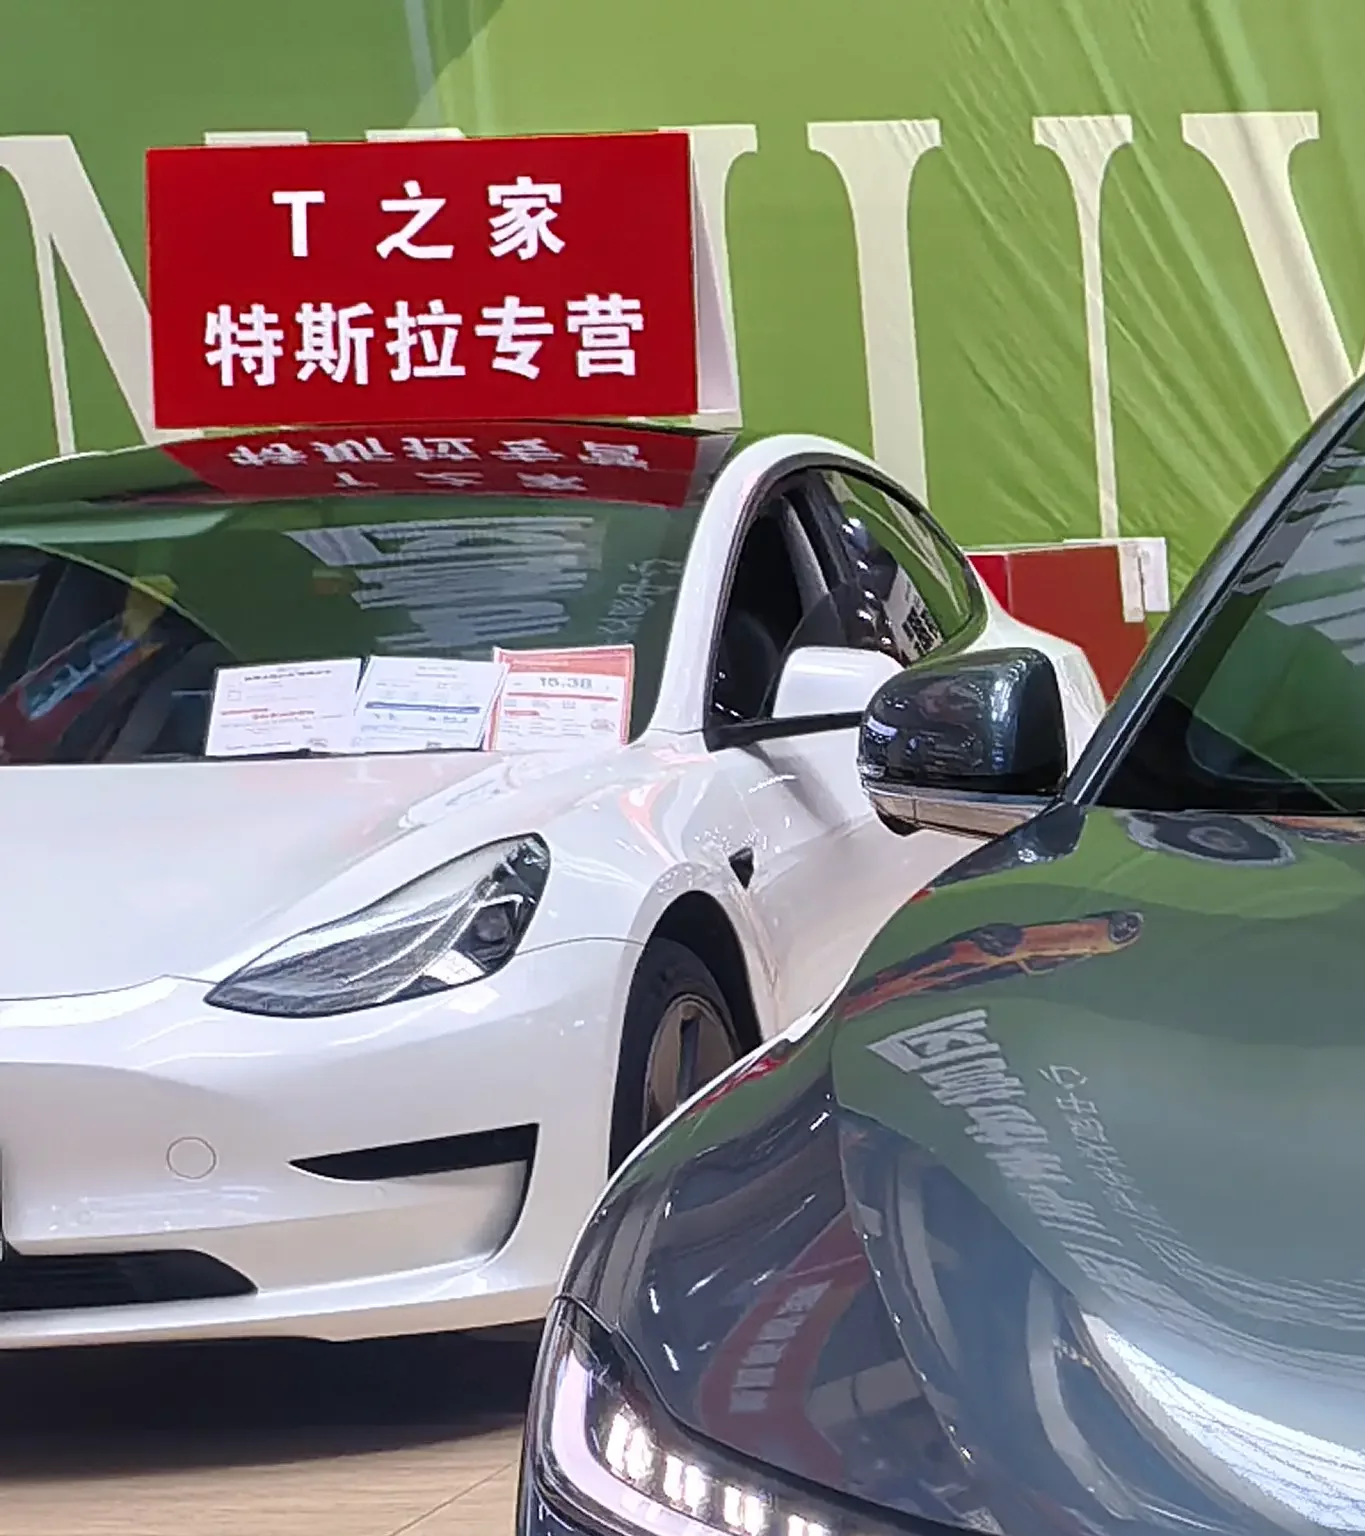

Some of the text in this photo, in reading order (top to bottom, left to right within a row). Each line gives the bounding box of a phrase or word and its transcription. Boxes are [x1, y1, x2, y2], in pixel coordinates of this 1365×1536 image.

[205, 293, 645, 388] 特斯拉专营
